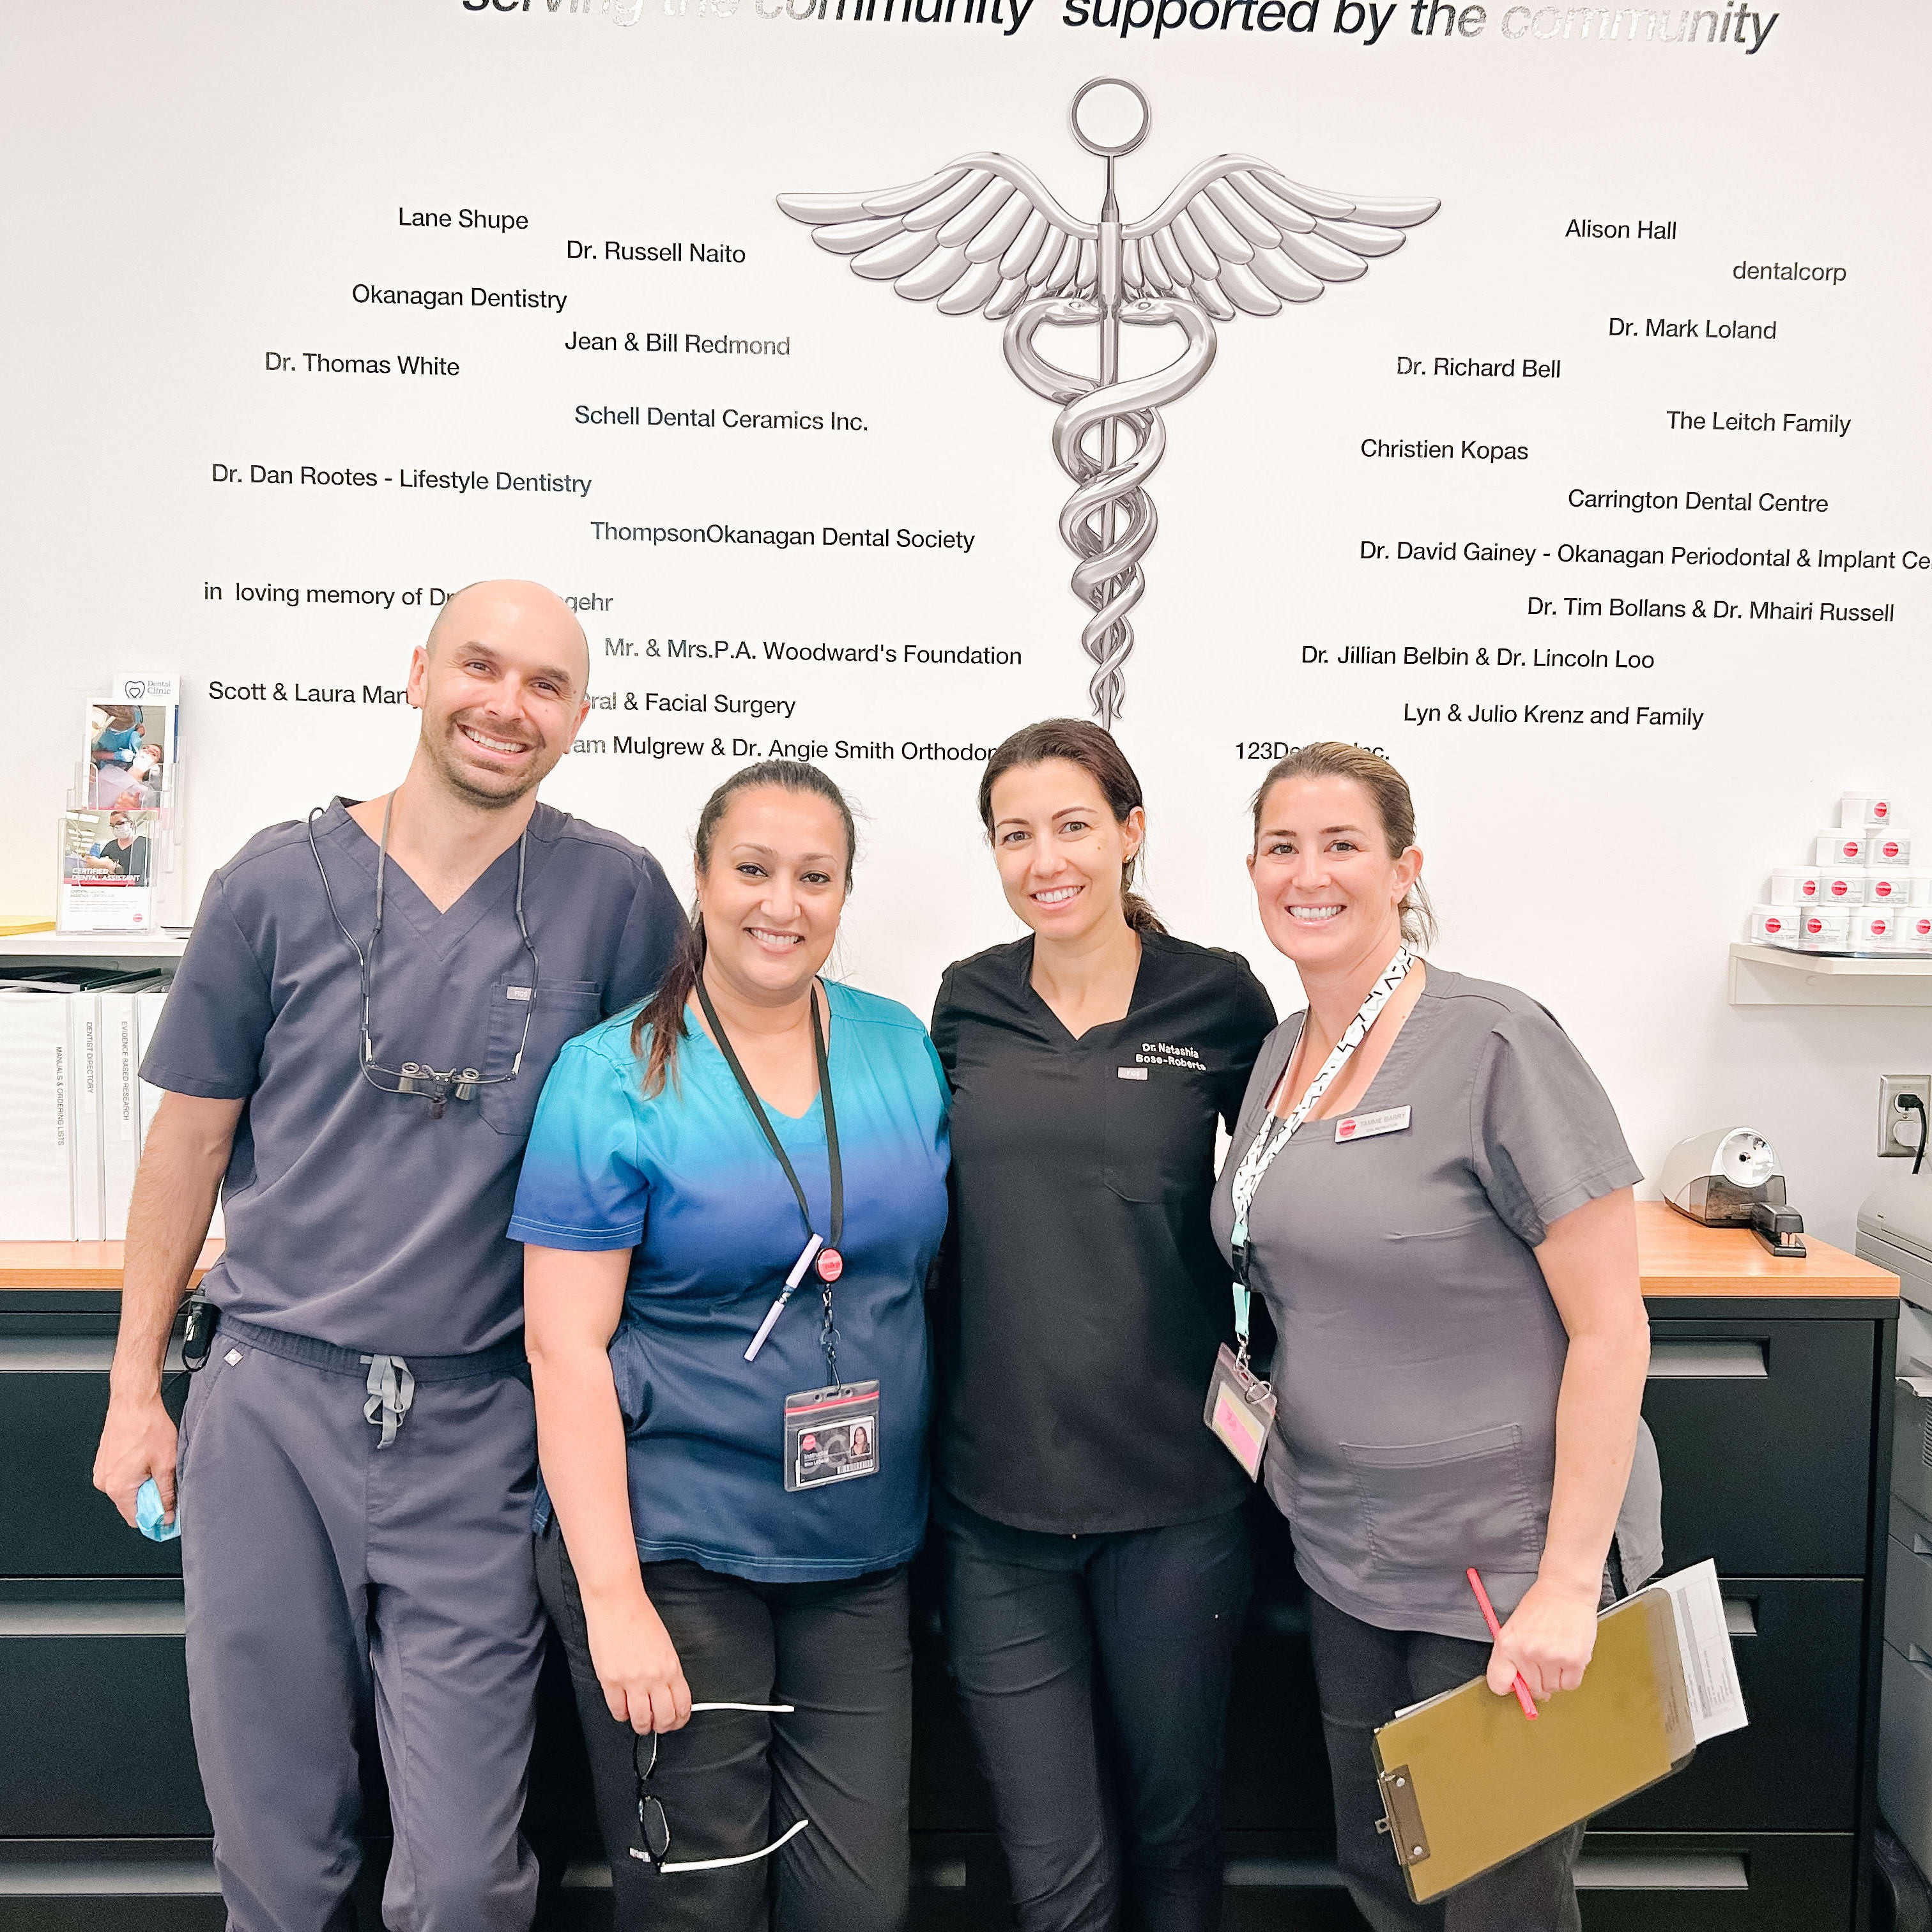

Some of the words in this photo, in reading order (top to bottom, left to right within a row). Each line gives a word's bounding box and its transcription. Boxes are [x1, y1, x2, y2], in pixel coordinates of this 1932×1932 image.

[1062, 0, 1314, 40] supported
[1332, 0, 1398, 47] by
[1409, 0, 1487, 38] the
[1501, 0, 1781, 55] community
[399, 207, 452, 227] Lane
[458, 208, 529, 234] Shupe
[1565, 218, 1630, 239] Alison
[1637, 220, 1676, 240] Hall
[567, 240, 597, 259] Dr.
[605, 241, 682, 262] Russell
[690, 243, 746, 263] Naito
[1733, 260, 1846, 286] dentalcorp
[352, 284, 463, 310] Okanagan
[471, 287, 568, 314] Dentistry
[1609, 317, 1638, 337] Dr.
[1646, 318, 1699, 338] Mark
[1705, 319, 1777, 339] Loland
[564, 331, 617, 351] Jean
[624, 332, 640, 351] &
[647, 333, 677, 353] Bill
[686, 334, 790, 356] Redmond
[266, 351, 296, 371] Dr.
[302, 353, 391, 374] Thomas
[397, 355, 460, 376] White
[1397, 356, 1426, 376] Dr.
[1434, 357, 1515, 378] Richard
[1522, 359, 1561, 378] Bell
[574, 404, 640, 425] Schell
[648, 406, 715, 427] Dental
[723, 408, 824, 430] Ceramics
[831, 411, 868, 431] Inc.
[1666, 410, 1706, 430] The
[1712, 411, 1775, 431] Leitch
[1782, 413, 1851, 438] Family
[1361, 438, 1453, 459] Christien
[1461, 440, 1528, 464] Kopas
[212, 463, 242, 483] Dr.
[250, 464, 293, 484] Dan
[301, 466, 378, 487] Rootes
[400, 468, 489, 494] Lifestyle
[496, 471, 592, 498] Dentistry
[1568, 489, 1678, 514] Carrington
[1685, 491, 1752, 511] Dental
[1758, 493, 1828, 512] Centre
[590, 521, 815, 549] ThompsonOkanagan
[822, 527, 889, 547] Dental
[896, 528, 976, 554] Society
[1360, 540, 1390, 560] Dr.
[1397, 541, 1457, 560] David
[1464, 542, 1537, 567] Gainey
[1558, 544, 1664, 569] Okanagan
[1671, 546, 1790, 567] Periodontal
[1797, 548, 1811, 567] &
[1818, 549, 1896, 572] Implant
[1902, 551, 1932, 570] Ce
[204, 581, 222, 601] in
[236, 582, 299, 607] loving
[307, 588, 395, 610] memory
[401, 587, 424, 606] of
[560, 592, 613, 613] gehr
[1528, 597, 1556, 615] Dr.
[1563, 597, 1602, 616] Tim
[1609, 598, 1686, 618] Bollans
[1692, 599, 1707, 618] &
[1713, 600, 1742, 619] Dr.
[1749, 601, 1813, 620] Mhairi
[1820, 602, 1894, 622] Russell
[605, 638, 638, 657] Mr.
[645, 638, 662, 657] &
[763, 641, 897, 663] Woodward's
[904, 645, 1022, 665] Foundation
[1302, 645, 1328, 664] Dr.
[1337, 645, 1396, 664] Jillian
[1404, 647, 1468, 666] Belbin
[1475, 647, 1491, 666] &
[1497, 648, 1526, 666] Dr.
[1533, 648, 1608, 668] Lincoln
[1615, 650, 1655, 669] Loo
[208, 680, 266, 700] Scott
[273, 682, 289, 702] &
[295, 683, 356, 703] Laura
[586, 692, 617, 710] ral
[624, 692, 639, 710] &
[646, 693, 707, 712] Facial
[714, 694, 796, 719] Surgery
[1404, 703, 1441, 726] Lyn
[1447, 703, 1463, 722] &
[1468, 704, 1517, 723] Julio
[1524, 705, 1584, 724] Krenz
[1590, 706, 1629, 724] and
[1636, 707, 1705, 730] Family
[573, 739, 606, 753] am
[613, 735, 705, 760] Mulgrew
[710, 737, 726, 756] &
[733, 739, 762, 756] Dr.
[768, 739, 829, 762] Angie
[834, 740, 894, 760] Smith
[1158, 1042, 1199, 1059] Natashia
